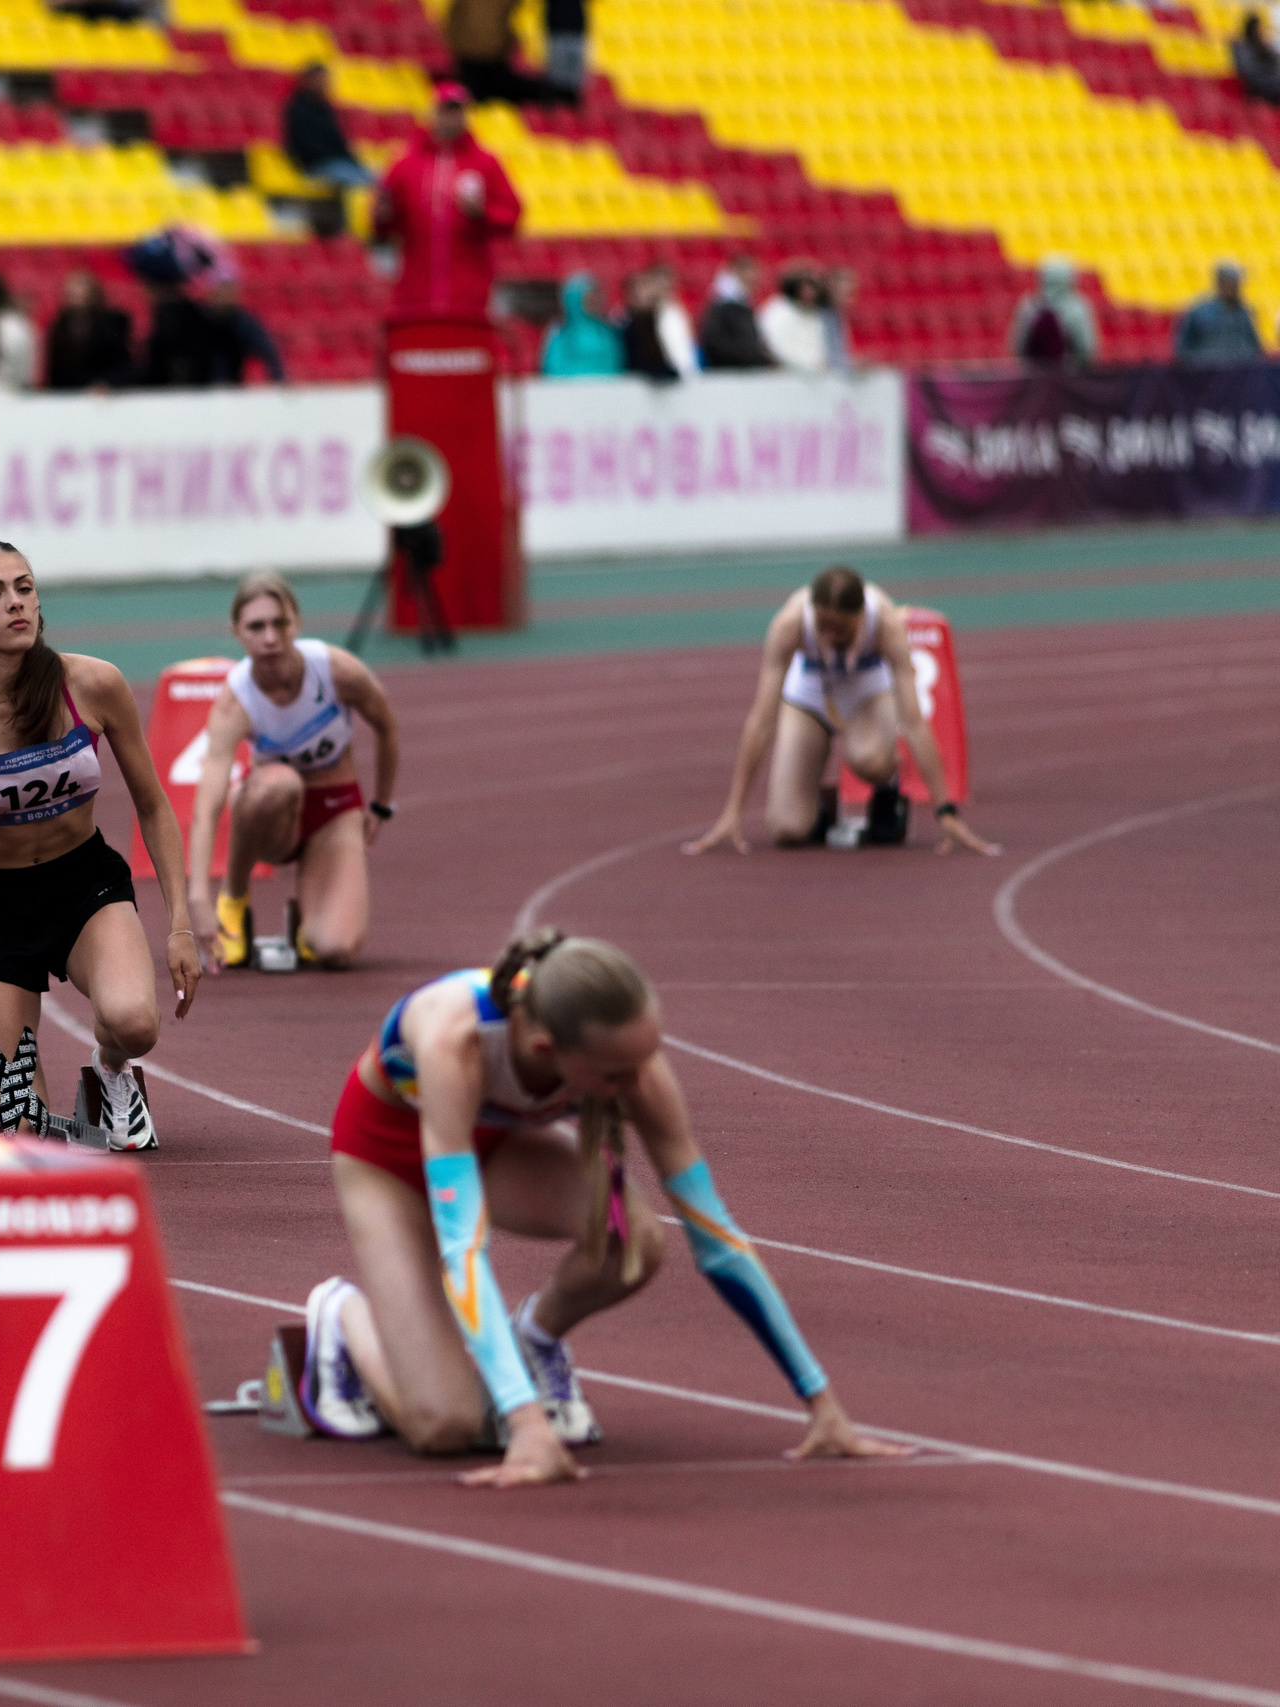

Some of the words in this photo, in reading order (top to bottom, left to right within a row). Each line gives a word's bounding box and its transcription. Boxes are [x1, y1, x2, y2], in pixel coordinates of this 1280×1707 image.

[5, 745, 63, 765] ПЕРВЕНСТВО
[0, 770, 81, 811] 124
[27, 808, 58, 821] ВФЛА
